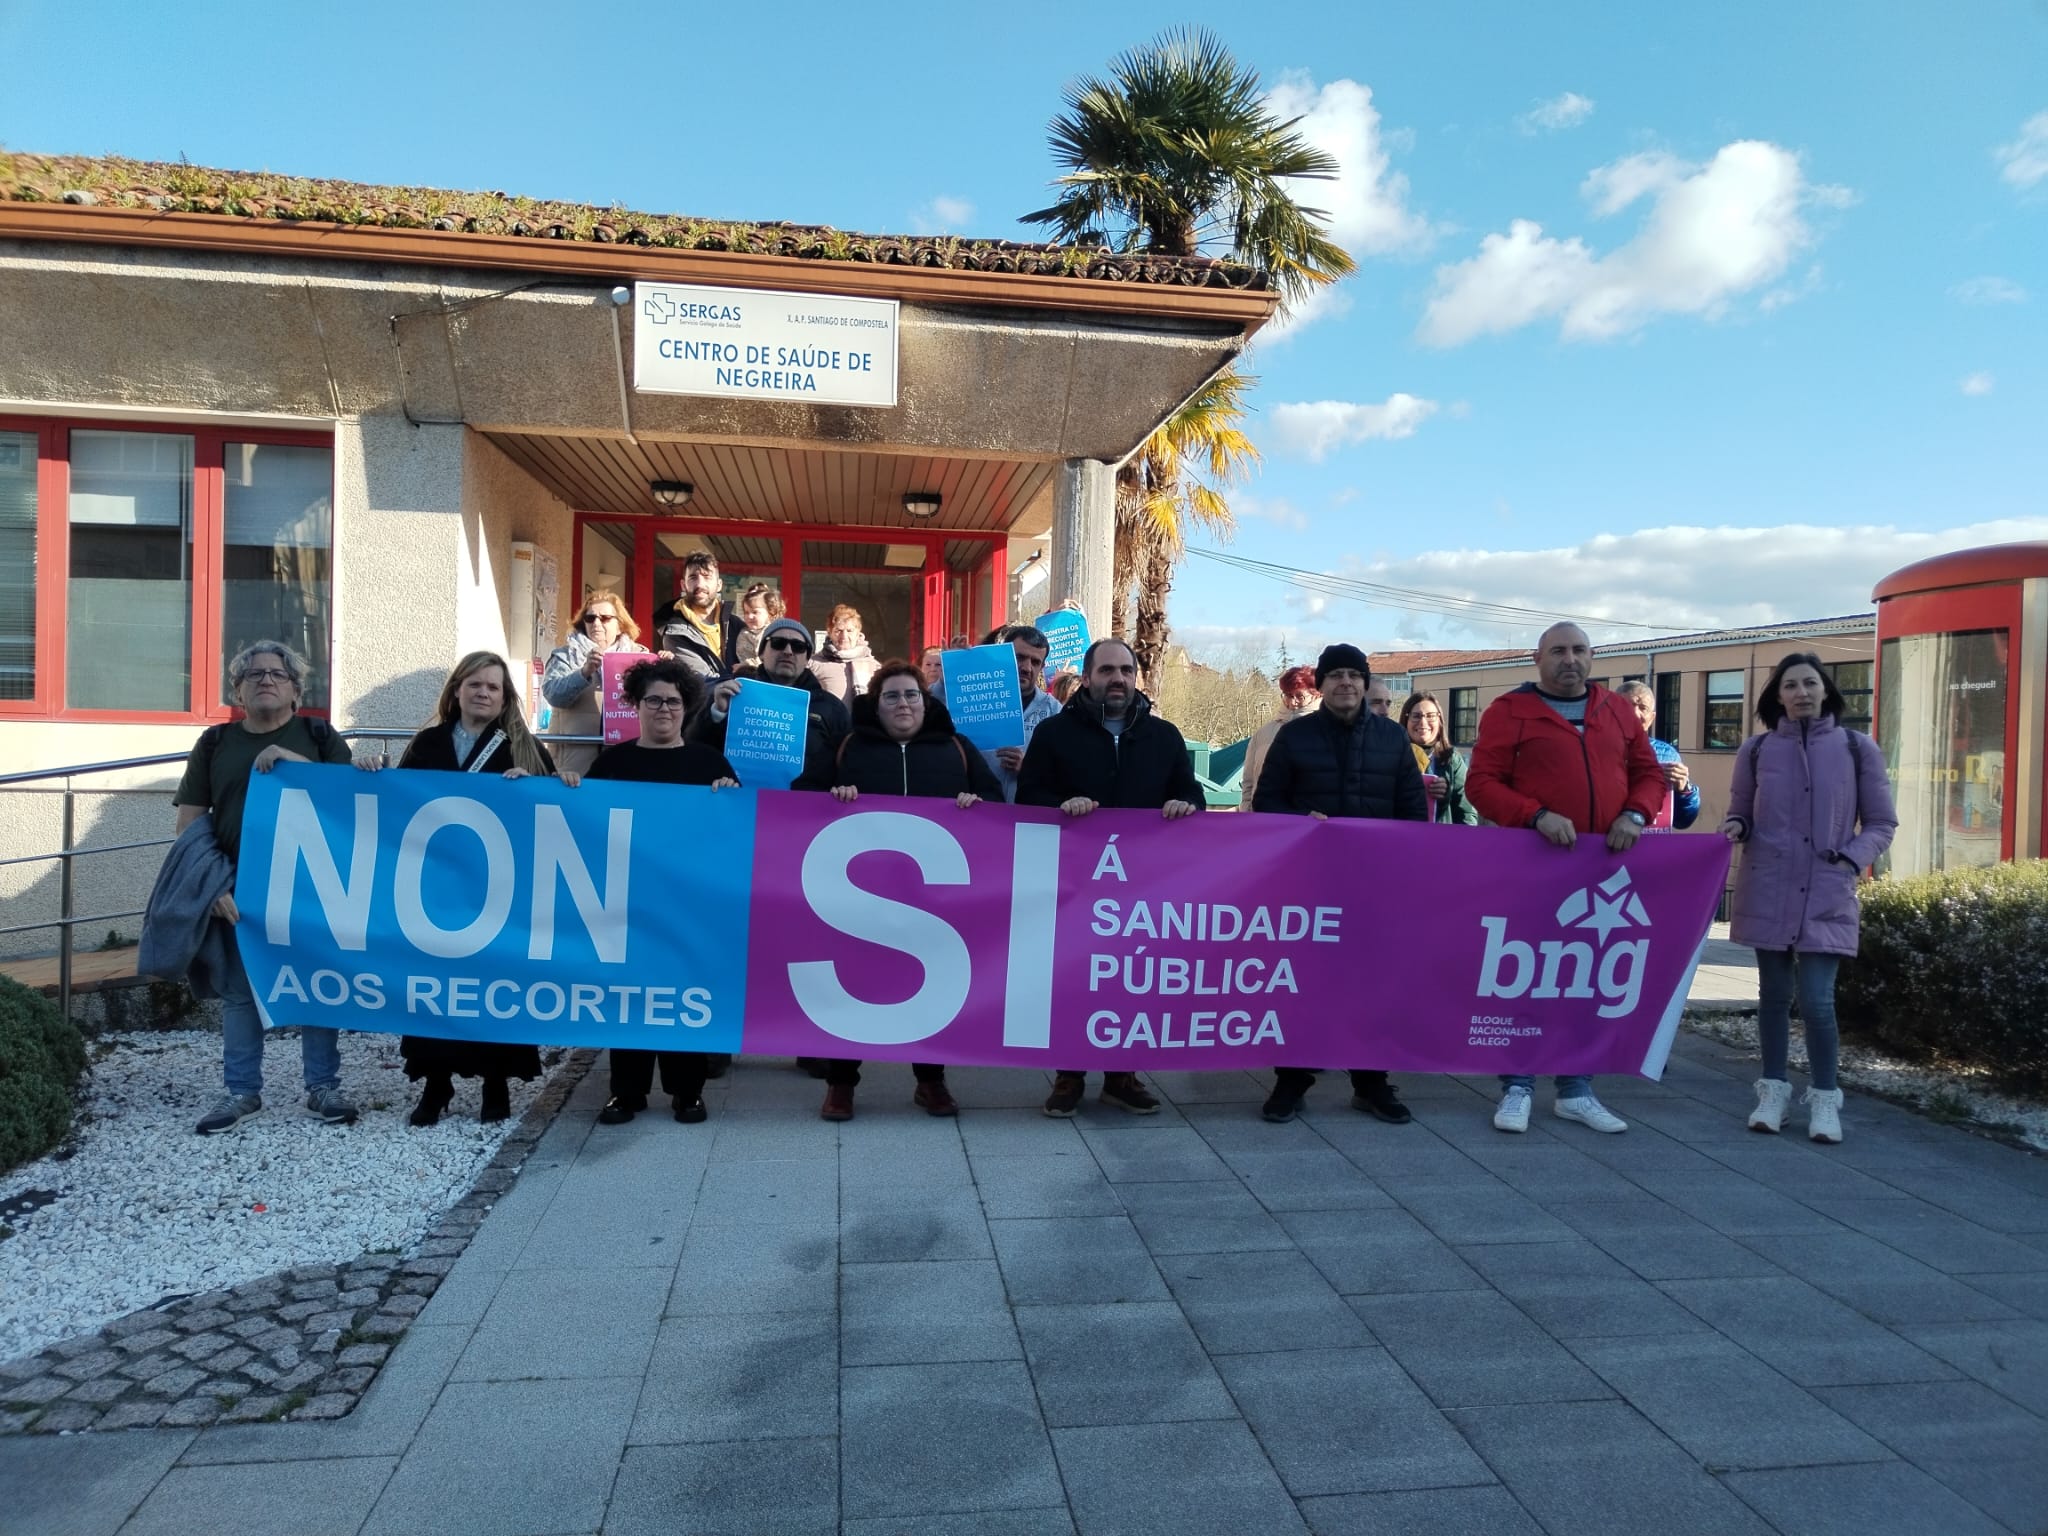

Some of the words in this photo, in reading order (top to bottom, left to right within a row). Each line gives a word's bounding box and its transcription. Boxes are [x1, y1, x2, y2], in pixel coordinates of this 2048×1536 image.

[680, 303, 741, 321] SERGAS
[808, 315, 838, 326] SANTIAGO
[840, 317, 848, 326] DE
[850, 318, 888, 328] COMPOSTELA
[659, 339, 738, 362] CENTRO
[746, 345, 770, 365] DE
[778, 344, 840, 369] SAÚDE
[848, 352, 872, 372] DE
[716, 367, 816, 391] NEGREIRA
[1044, 627, 1070, 637] CONTRA
[956, 672, 992, 683] CONTRA
[993, 670, 1006, 678] OS
[960, 680, 1004, 693] RECORTES
[956, 696, 968, 704] DA
[970, 692, 998, 702] XUNTA
[1000, 690, 1011, 698] DE
[744, 706, 780, 718] CONTRA
[782, 712, 794, 721] OS
[963, 703, 993, 713] GALIZA
[995, 702, 1006, 710] EN
[744, 718, 791, 731] RECORTES
[737, 728, 750, 736] DA
[752, 730, 782, 740] XUNTA
[784, 734, 796, 742] DE
[742, 739, 774, 750] GALIZA
[776, 743, 789, 752] EN
[727, 748, 801, 764] NUTRICIONISTAS
[1092, 834, 1128, 882] Á
[265, 787, 634, 963] NON
[1090, 898, 1342, 944] SANIDADE
[787, 811, 1060, 1049] SI
[1090, 946, 1298, 996] PÚBLICA
[1476, 916, 1650, 1018] bng
[268, 965, 387, 1010] AOS
[406, 974, 712, 1028] RECORTES
[1471, 1015, 1514, 1026] BLOQUE
[1086, 1010, 1285, 1050] GALEGA
[1469, 1026, 1542, 1036] NACIONALISTA
[1468, 1036, 1510, 1047] GALEGO
